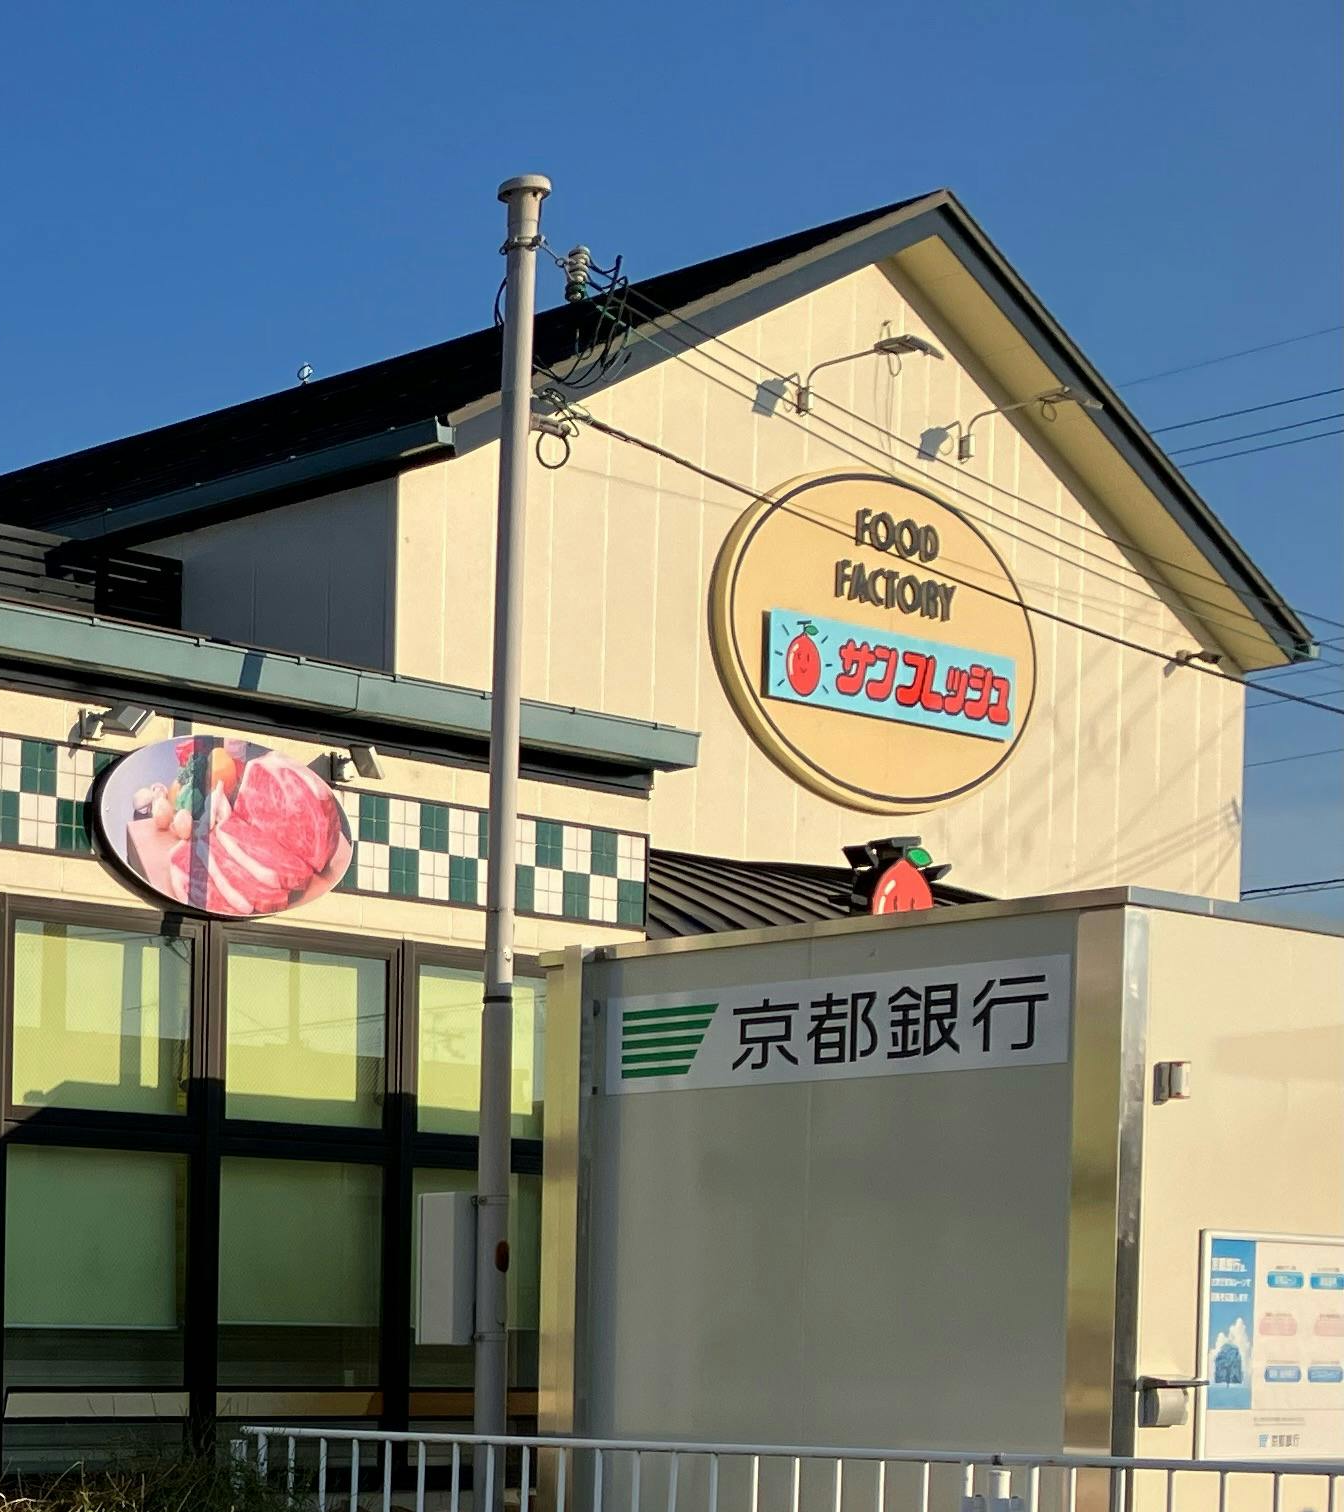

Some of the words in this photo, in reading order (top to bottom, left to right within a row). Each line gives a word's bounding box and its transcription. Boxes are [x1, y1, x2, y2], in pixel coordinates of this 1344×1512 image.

[855, 508, 940, 563] FOOD
[834, 559, 957, 622] FACTORY
[835, 638, 1011, 726] サンフレッシュ
[731, 974, 1050, 1071] 京都銀行
